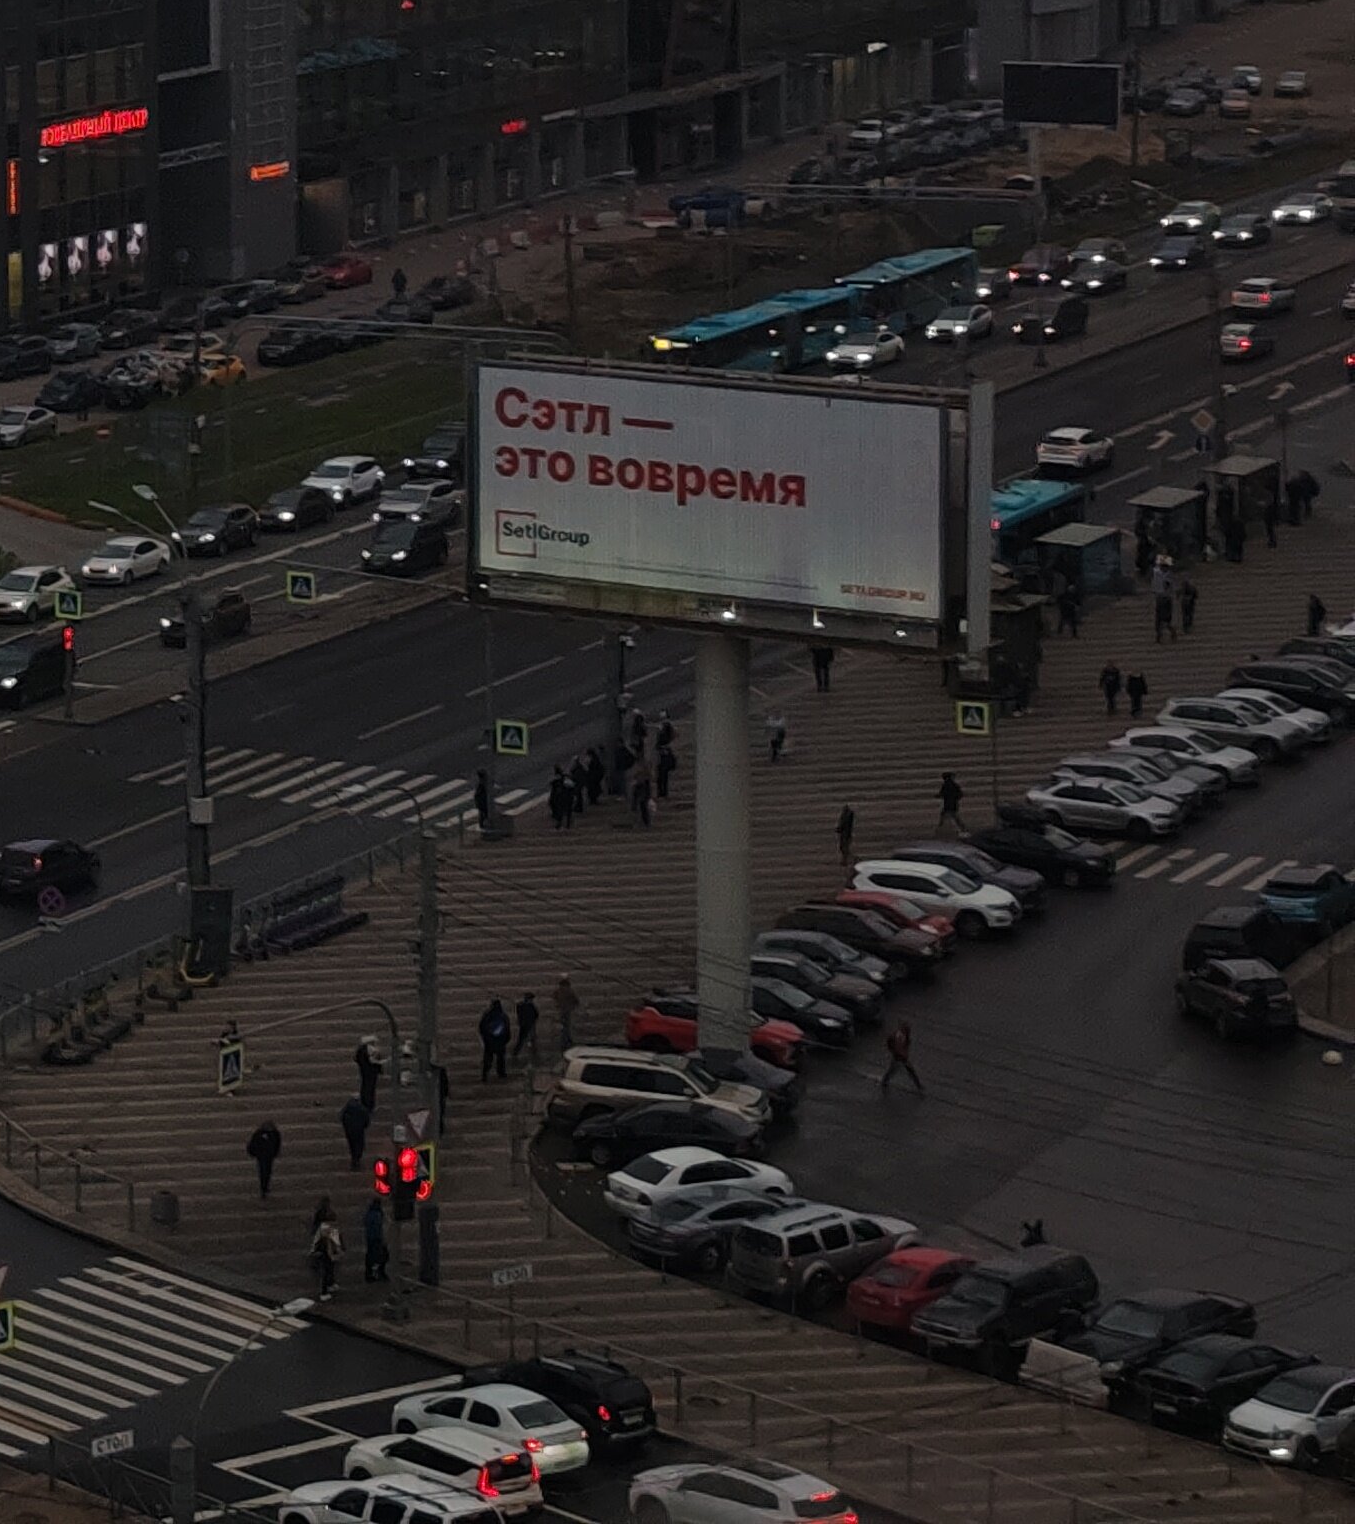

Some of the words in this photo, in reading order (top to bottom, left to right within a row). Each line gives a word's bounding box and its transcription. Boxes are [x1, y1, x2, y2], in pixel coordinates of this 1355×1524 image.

[495, 387, 611, 436] Сэтл
[495, 446, 575, 482] это
[589, 454, 806, 507] вовремя
[502, 520, 590, 547] SetlGroup
